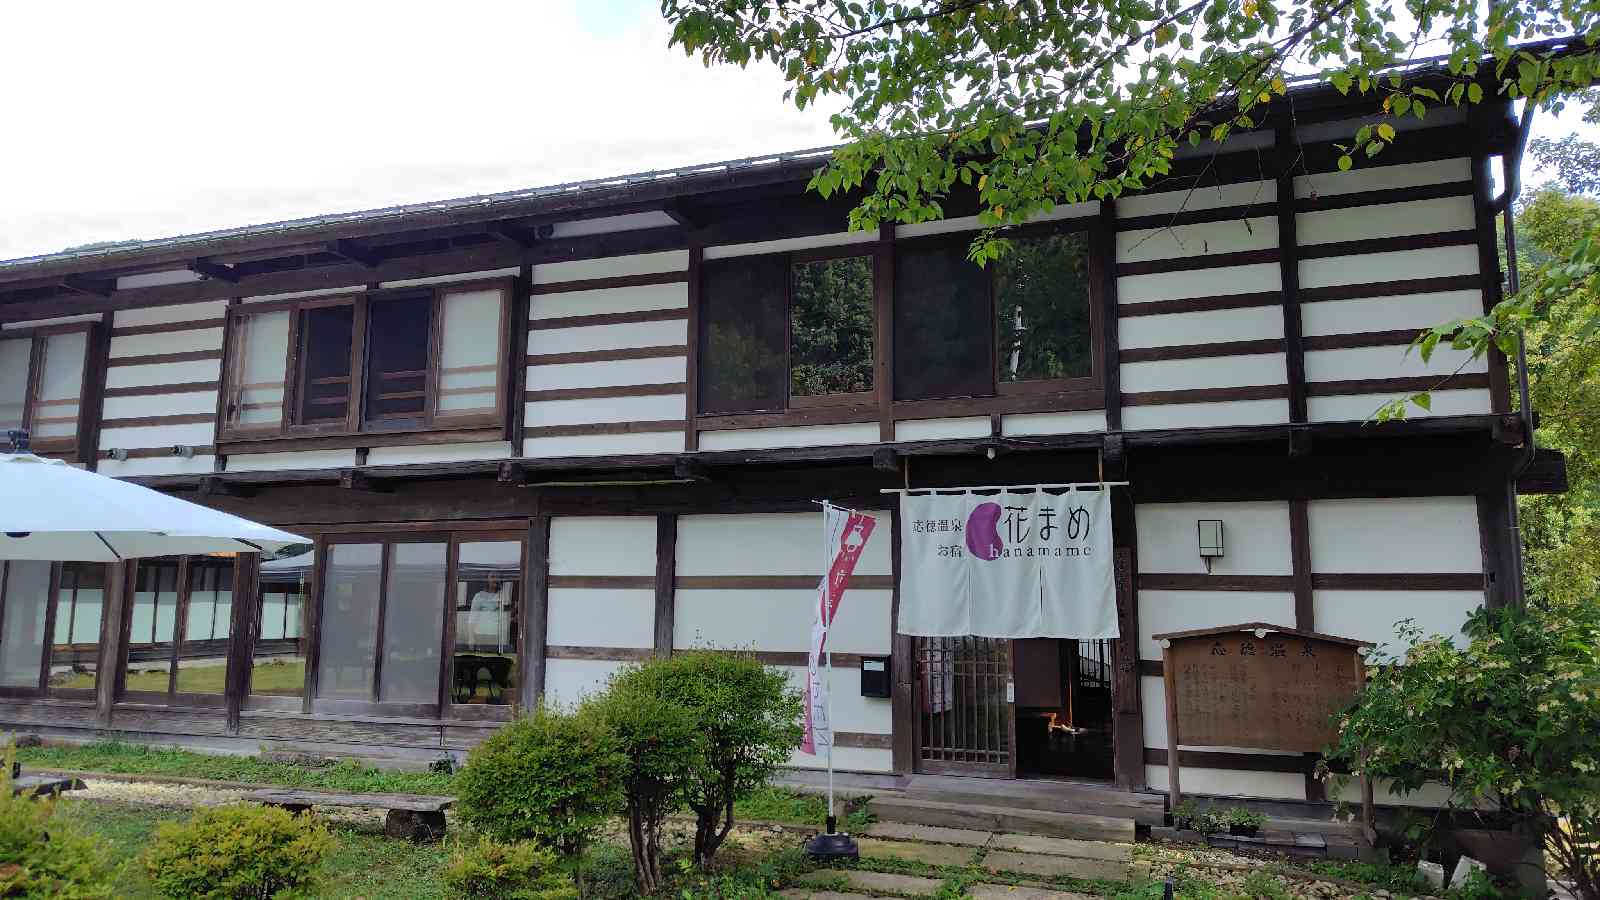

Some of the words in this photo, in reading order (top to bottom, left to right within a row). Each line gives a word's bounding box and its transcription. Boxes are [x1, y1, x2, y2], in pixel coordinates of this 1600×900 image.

[999, 505, 1090, 544] 花まめ
[937, 544, 962, 558] お宿
[990, 544, 1092, 558] hanamame
